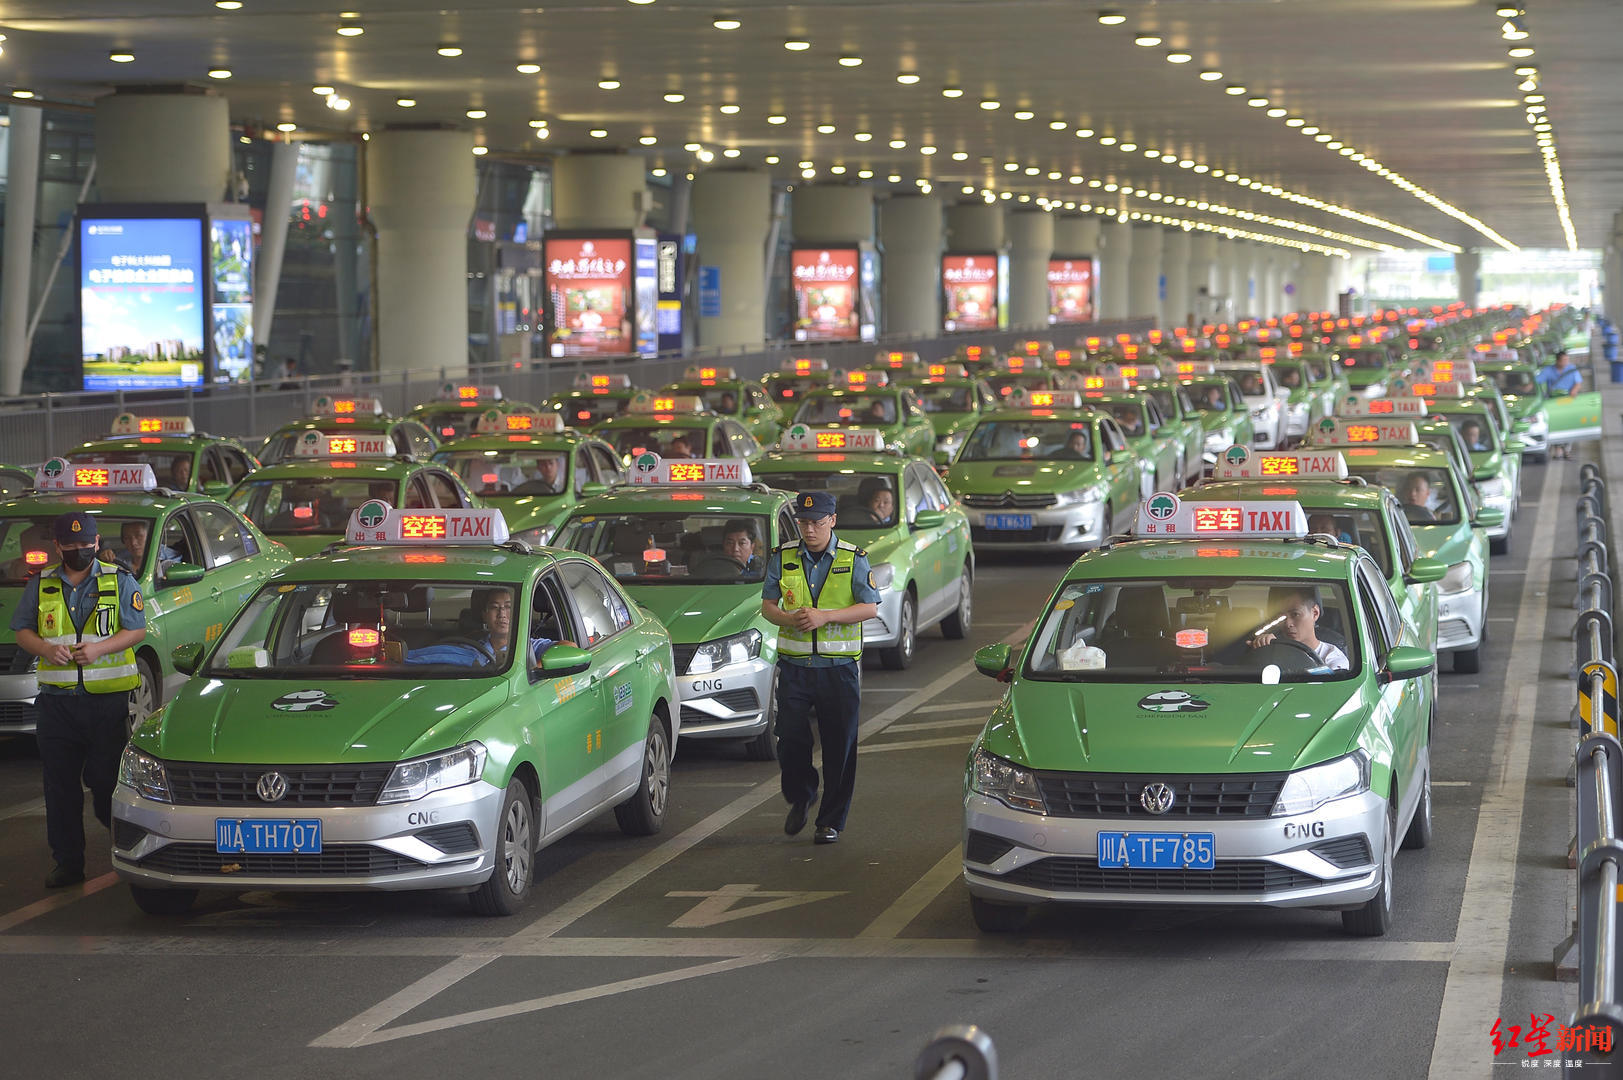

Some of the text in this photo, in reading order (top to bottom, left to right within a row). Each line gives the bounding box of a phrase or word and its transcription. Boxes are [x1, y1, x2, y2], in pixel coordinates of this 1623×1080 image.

[164, 421, 185, 431] TAXI
[1347, 425, 1409, 442] 空车 TAXI
[329, 439, 356, 454] 空车
[360, 441, 384, 453] TAXI
[816, 433, 846, 448] 空车
[849, 435, 875, 447] TAXI
[669, 464, 739, 481] 空车 TAXI
[1261, 457, 1335, 475] 空车 TAXI
[75, 469, 142, 487] 空车 TAXI
[402, 514, 491, 539] 空车 TAXI
[1147, 524, 1176, 533] 出租
[1195, 508, 1290, 532] 空车 TAXI
[355, 531, 387, 542] 出租
[350, 631, 378, 645] 空车
[692, 678, 723, 692] CNG
[408, 811, 440, 825] CNG
[219, 824, 318, 849] 川A·TH707
[1284, 821, 1325, 839] CNG
[1102, 838, 1211, 864] 川A·TF785
